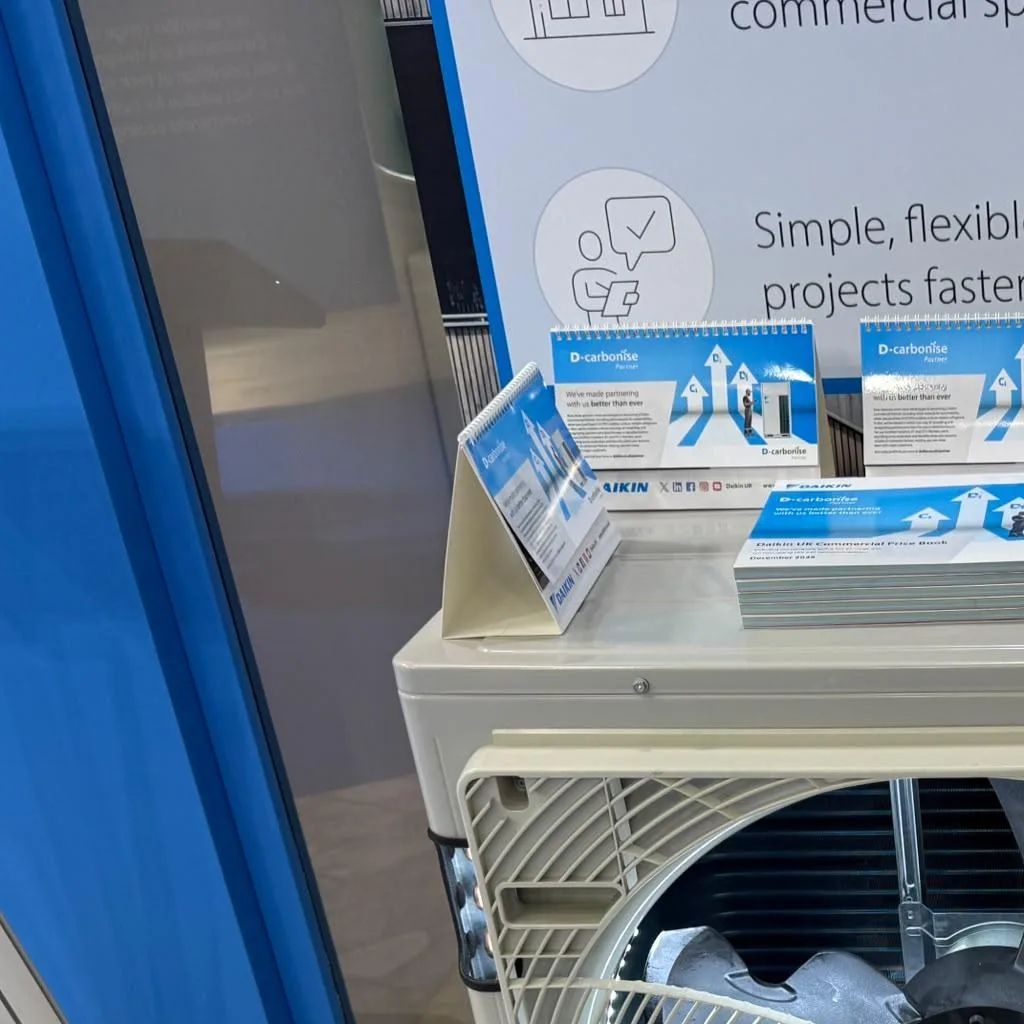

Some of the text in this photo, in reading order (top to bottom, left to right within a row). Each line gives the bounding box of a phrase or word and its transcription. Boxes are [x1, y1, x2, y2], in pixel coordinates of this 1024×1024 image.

[731, 0, 967, 30] commercial
[755, 205, 895, 256] Simple,
[763, 270, 913, 319] projects
[570, 348, 639, 363] D-carbonise
[878, 341, 948, 355] D-carbonise
[603, 481, 649, 493] AIKIN
